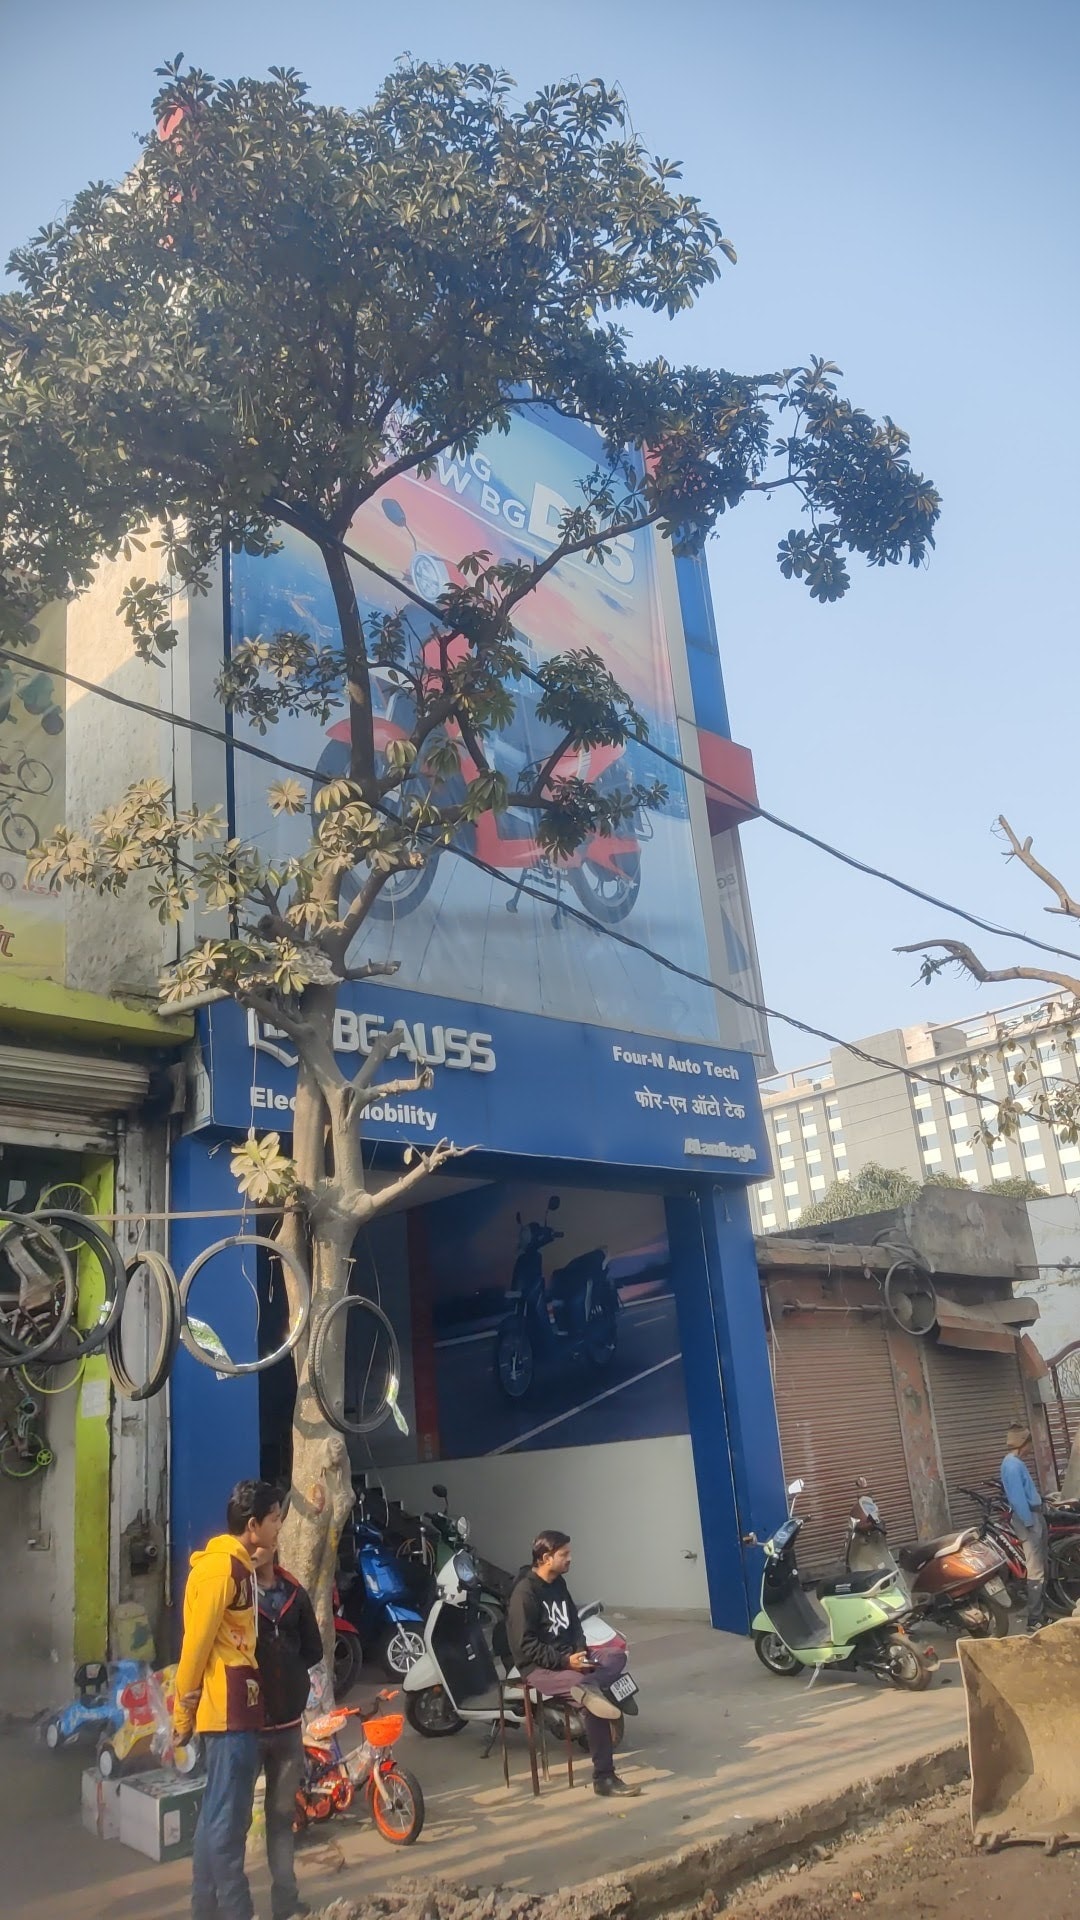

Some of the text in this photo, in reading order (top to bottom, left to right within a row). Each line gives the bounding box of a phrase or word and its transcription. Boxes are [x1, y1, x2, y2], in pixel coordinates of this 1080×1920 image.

[480, 483, 527, 530] BG
[332, 1008, 497, 1073] BGAUSS
[612, 1045, 740, 1080] Four-N Auto Tech
[250, 1086, 296, 1112] Elec
[634, 1085, 746, 1119] फोर-एन ऑटो टेक
